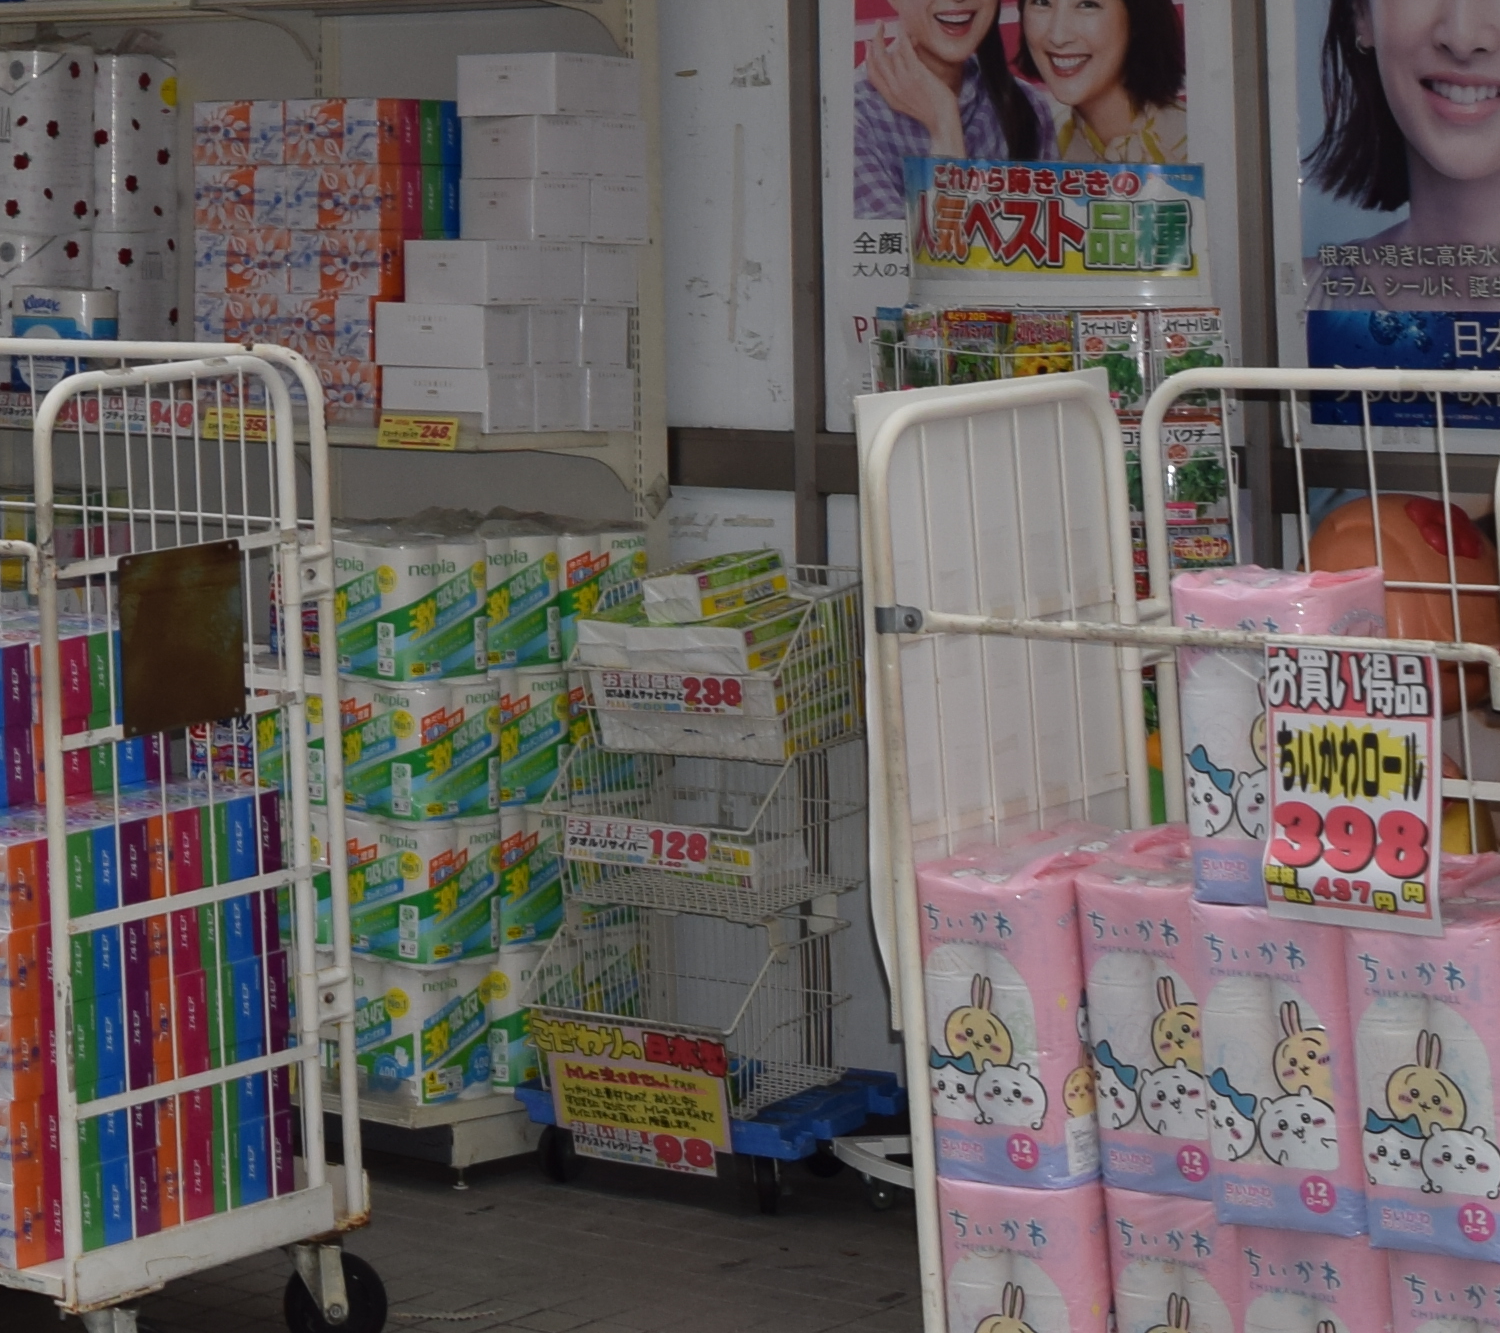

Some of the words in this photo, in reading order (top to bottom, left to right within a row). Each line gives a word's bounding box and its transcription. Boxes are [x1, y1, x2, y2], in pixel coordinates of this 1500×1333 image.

[933, 165, 1141, 197] これから蒔きどきの
[915, 191, 1193, 270] 人気ベスト品種
[1321, 277, 1376, 297] セラム
[407, 558, 456, 578] nepia
[1267, 647, 1430, 717] お買い得品
[1276, 719, 1424, 802] ちいかわロール
[649, 829, 708, 863] 128
[1270, 800, 1430, 879] 398
[923, 903, 1014, 940] ちいかわ
[1087, 910, 1181, 947] ちいかわ
[1203, 932, 1308, 971] ちいかわ
[1356, 951, 1467, 992] ちいかわ
[1305, 1180, 1329, 1197] 12
[948, 1208, 1048, 1249] ちいかわ
[1463, 1209, 1488, 1226] 12
